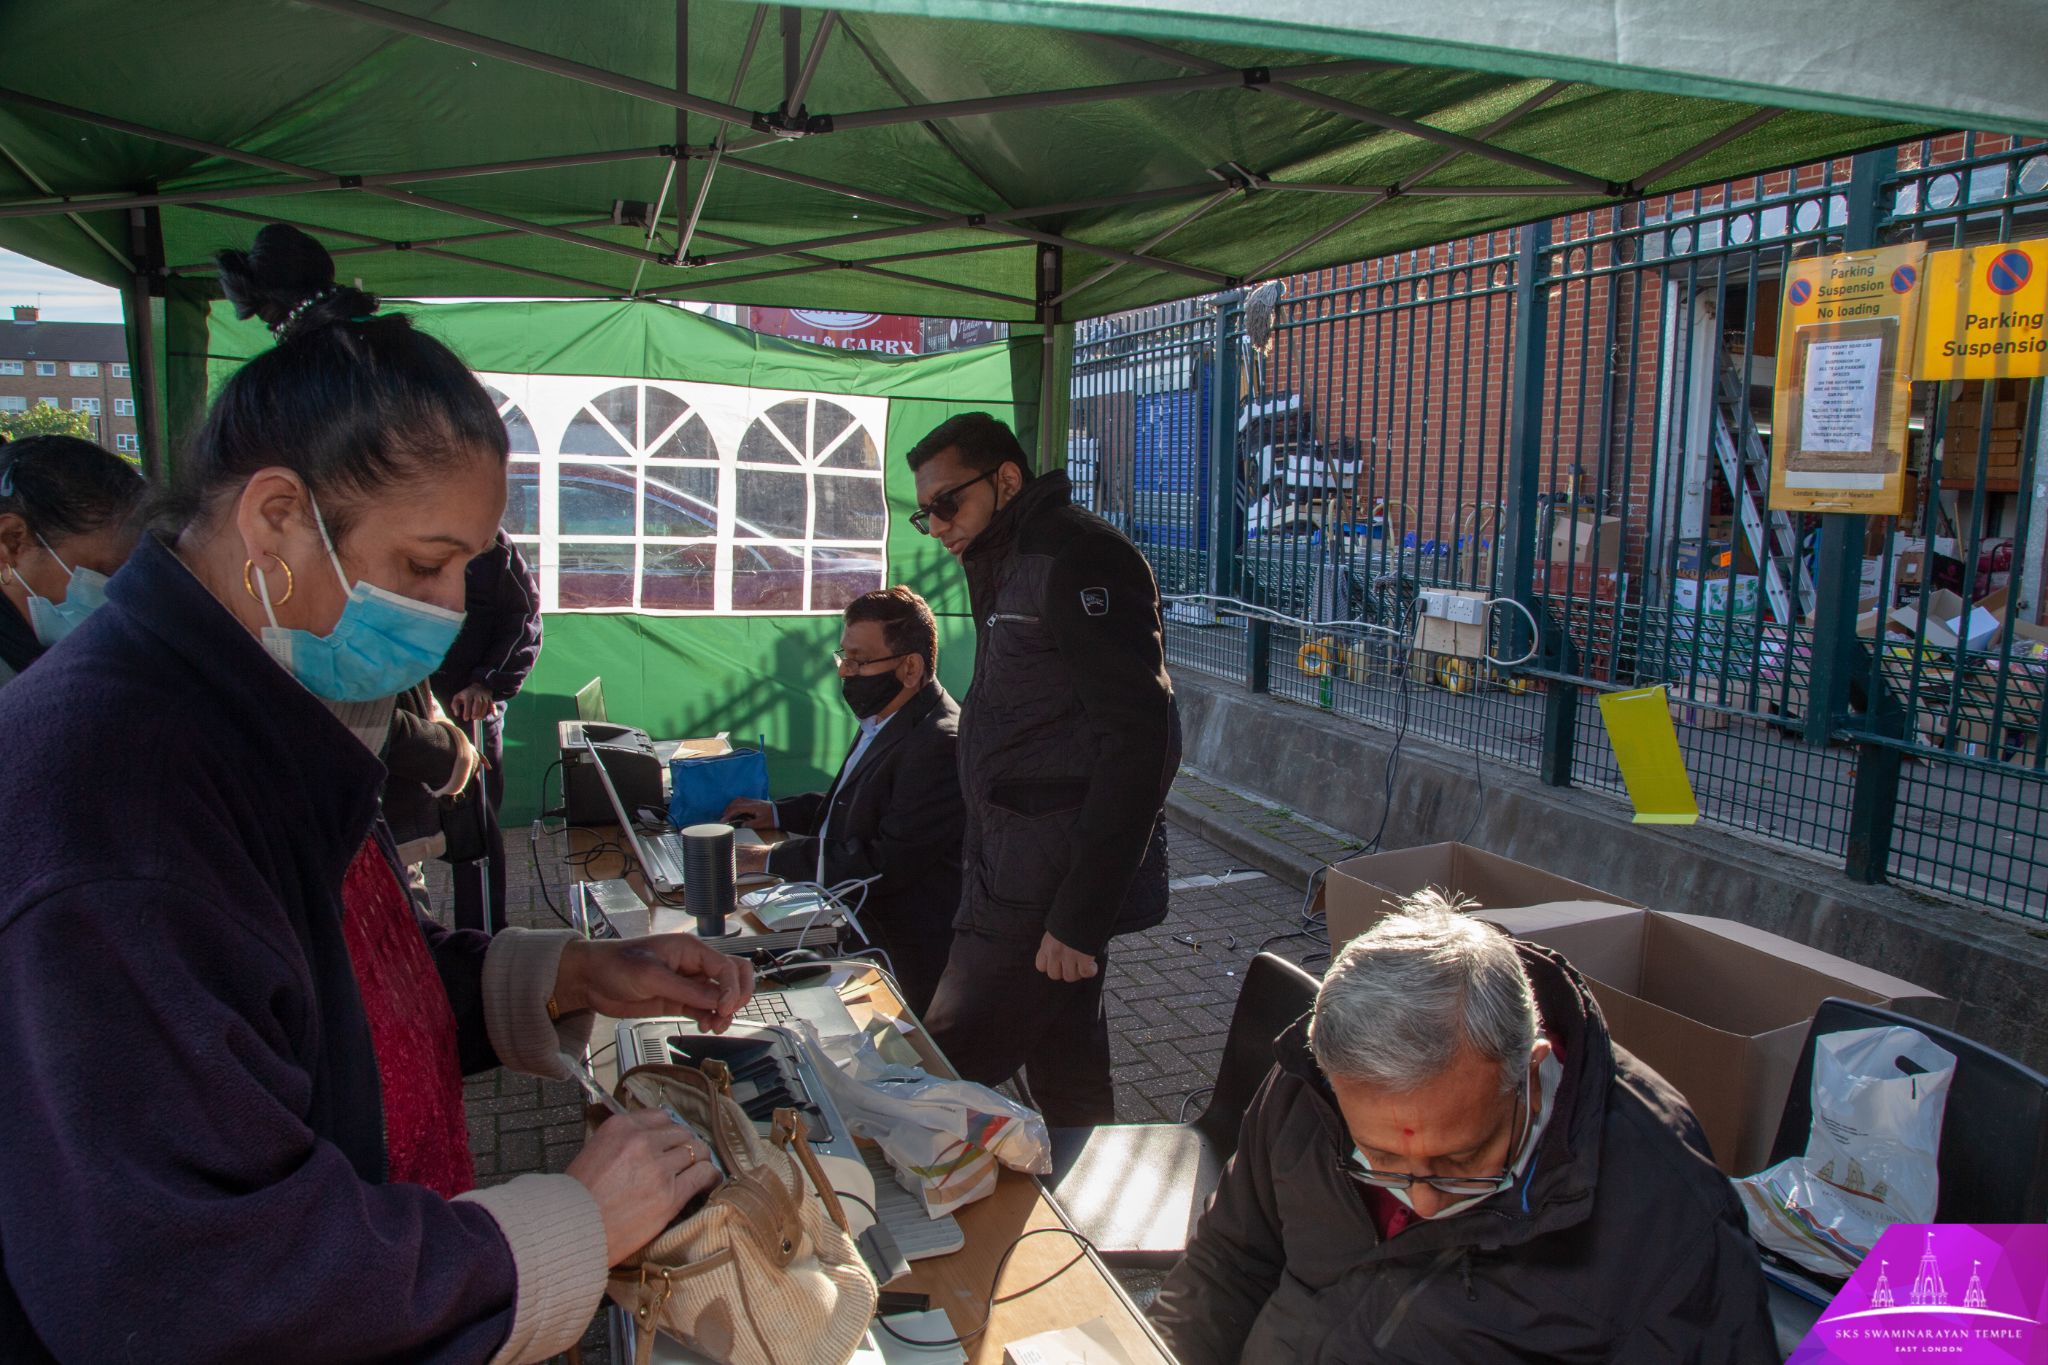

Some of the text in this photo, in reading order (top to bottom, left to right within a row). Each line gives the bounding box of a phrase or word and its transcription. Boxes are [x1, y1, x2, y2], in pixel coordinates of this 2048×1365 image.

[1830, 265, 1875, 280] Parking
[1817, 280, 1884, 297] Suspension
[1817, 303, 1880, 319] No loading
[1964, 311, 2044, 330] Parking
[841, 337, 913, 355] CARRY
[1942, 336, 2048, 358] Suspensio
